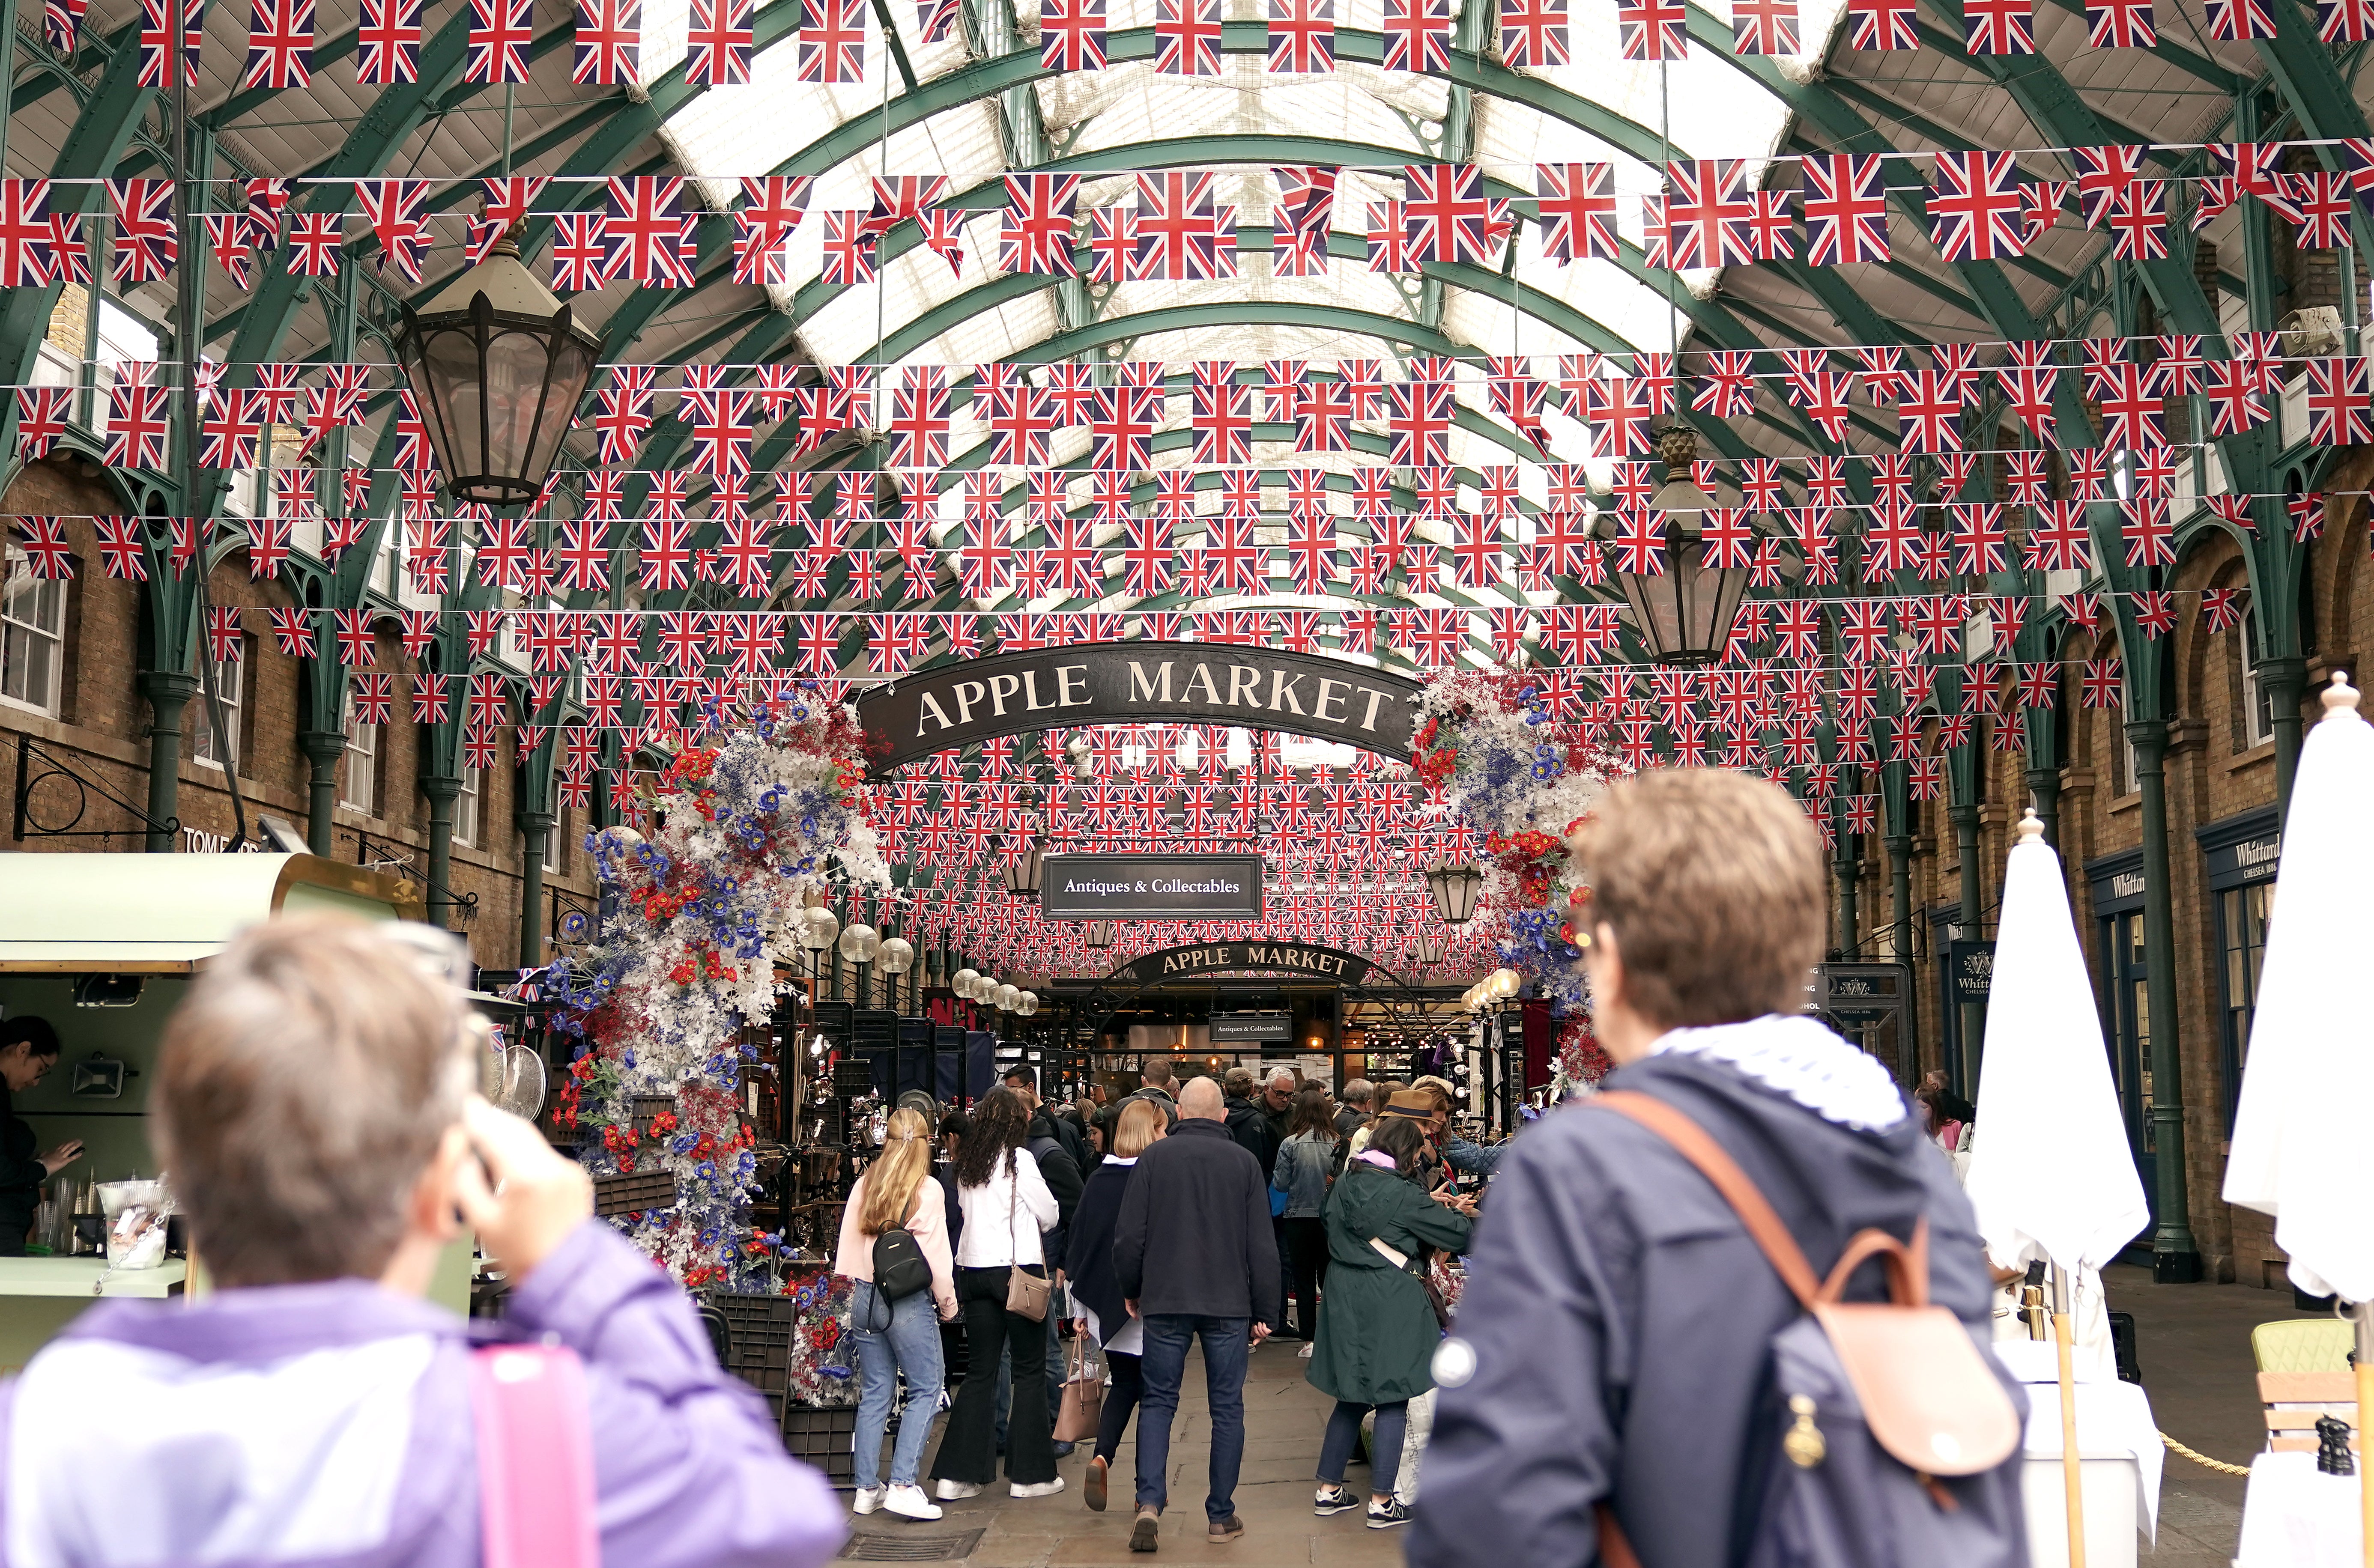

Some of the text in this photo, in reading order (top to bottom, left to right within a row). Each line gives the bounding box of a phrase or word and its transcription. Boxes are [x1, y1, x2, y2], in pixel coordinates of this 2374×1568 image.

[915, 661, 1394, 737] APPLE MARKET
[183, 826, 217, 853] TOM
[2236, 833, 2281, 867] Whittard
[2244, 865, 2265, 879] CHELSEA
[1064, 878, 1240, 896] Antiques & Collectables
[1163, 946, 1349, 975] APPLE MARKET
[1958, 978, 1991, 989] Whitt
[1394, 1505, 1403, 1519] N
